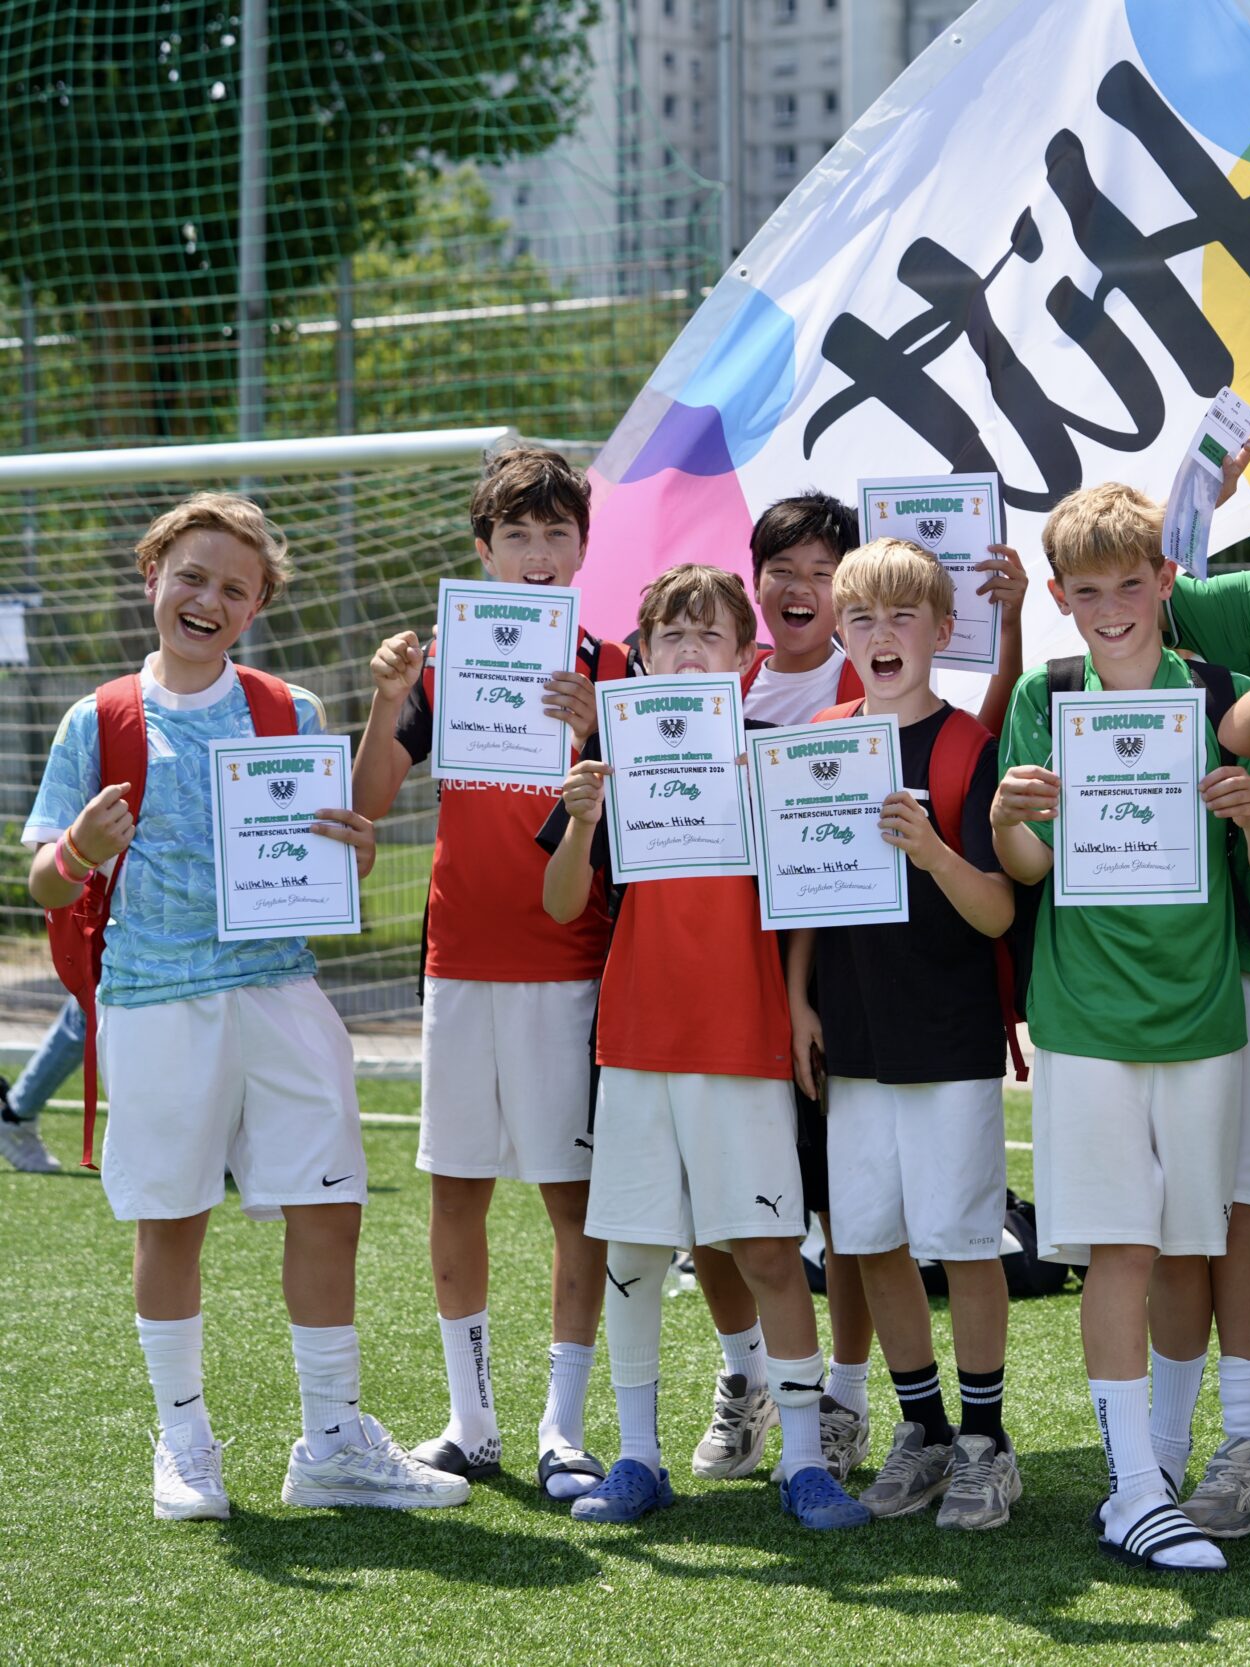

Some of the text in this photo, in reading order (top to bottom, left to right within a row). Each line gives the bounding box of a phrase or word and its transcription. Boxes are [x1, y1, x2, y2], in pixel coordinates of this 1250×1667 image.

[896, 498, 964, 515] URKUNDE
[474, 604, 542, 622] URKUNDE
[511, 660, 542, 670] MÜNSTER
[459, 672, 534, 683] PARTNERSCHULTURNIER
[635, 696, 704, 715] URKUNDE
[1092, 713, 1165, 732] URKUNDE
[787, 739, 859, 759] URKUNDE
[682, 751, 713, 760] MÜNSTER
[247, 758, 315, 776] URKUNDE
[629, 767, 707, 778] PARTNERSCHULTURNIER
[1137, 772, 1170, 781] MÜNSTER
[1080, 788, 1163, 796] PARTNERSCHULTURNIER
[835, 793, 868, 803] MÜNSTER
[291, 813, 319, 821] MÜNST
[780, 807, 881, 820] PARTNERSCHULTURNIER 2026
[239, 827, 311, 837] PARTNERSCHULTURNIE
